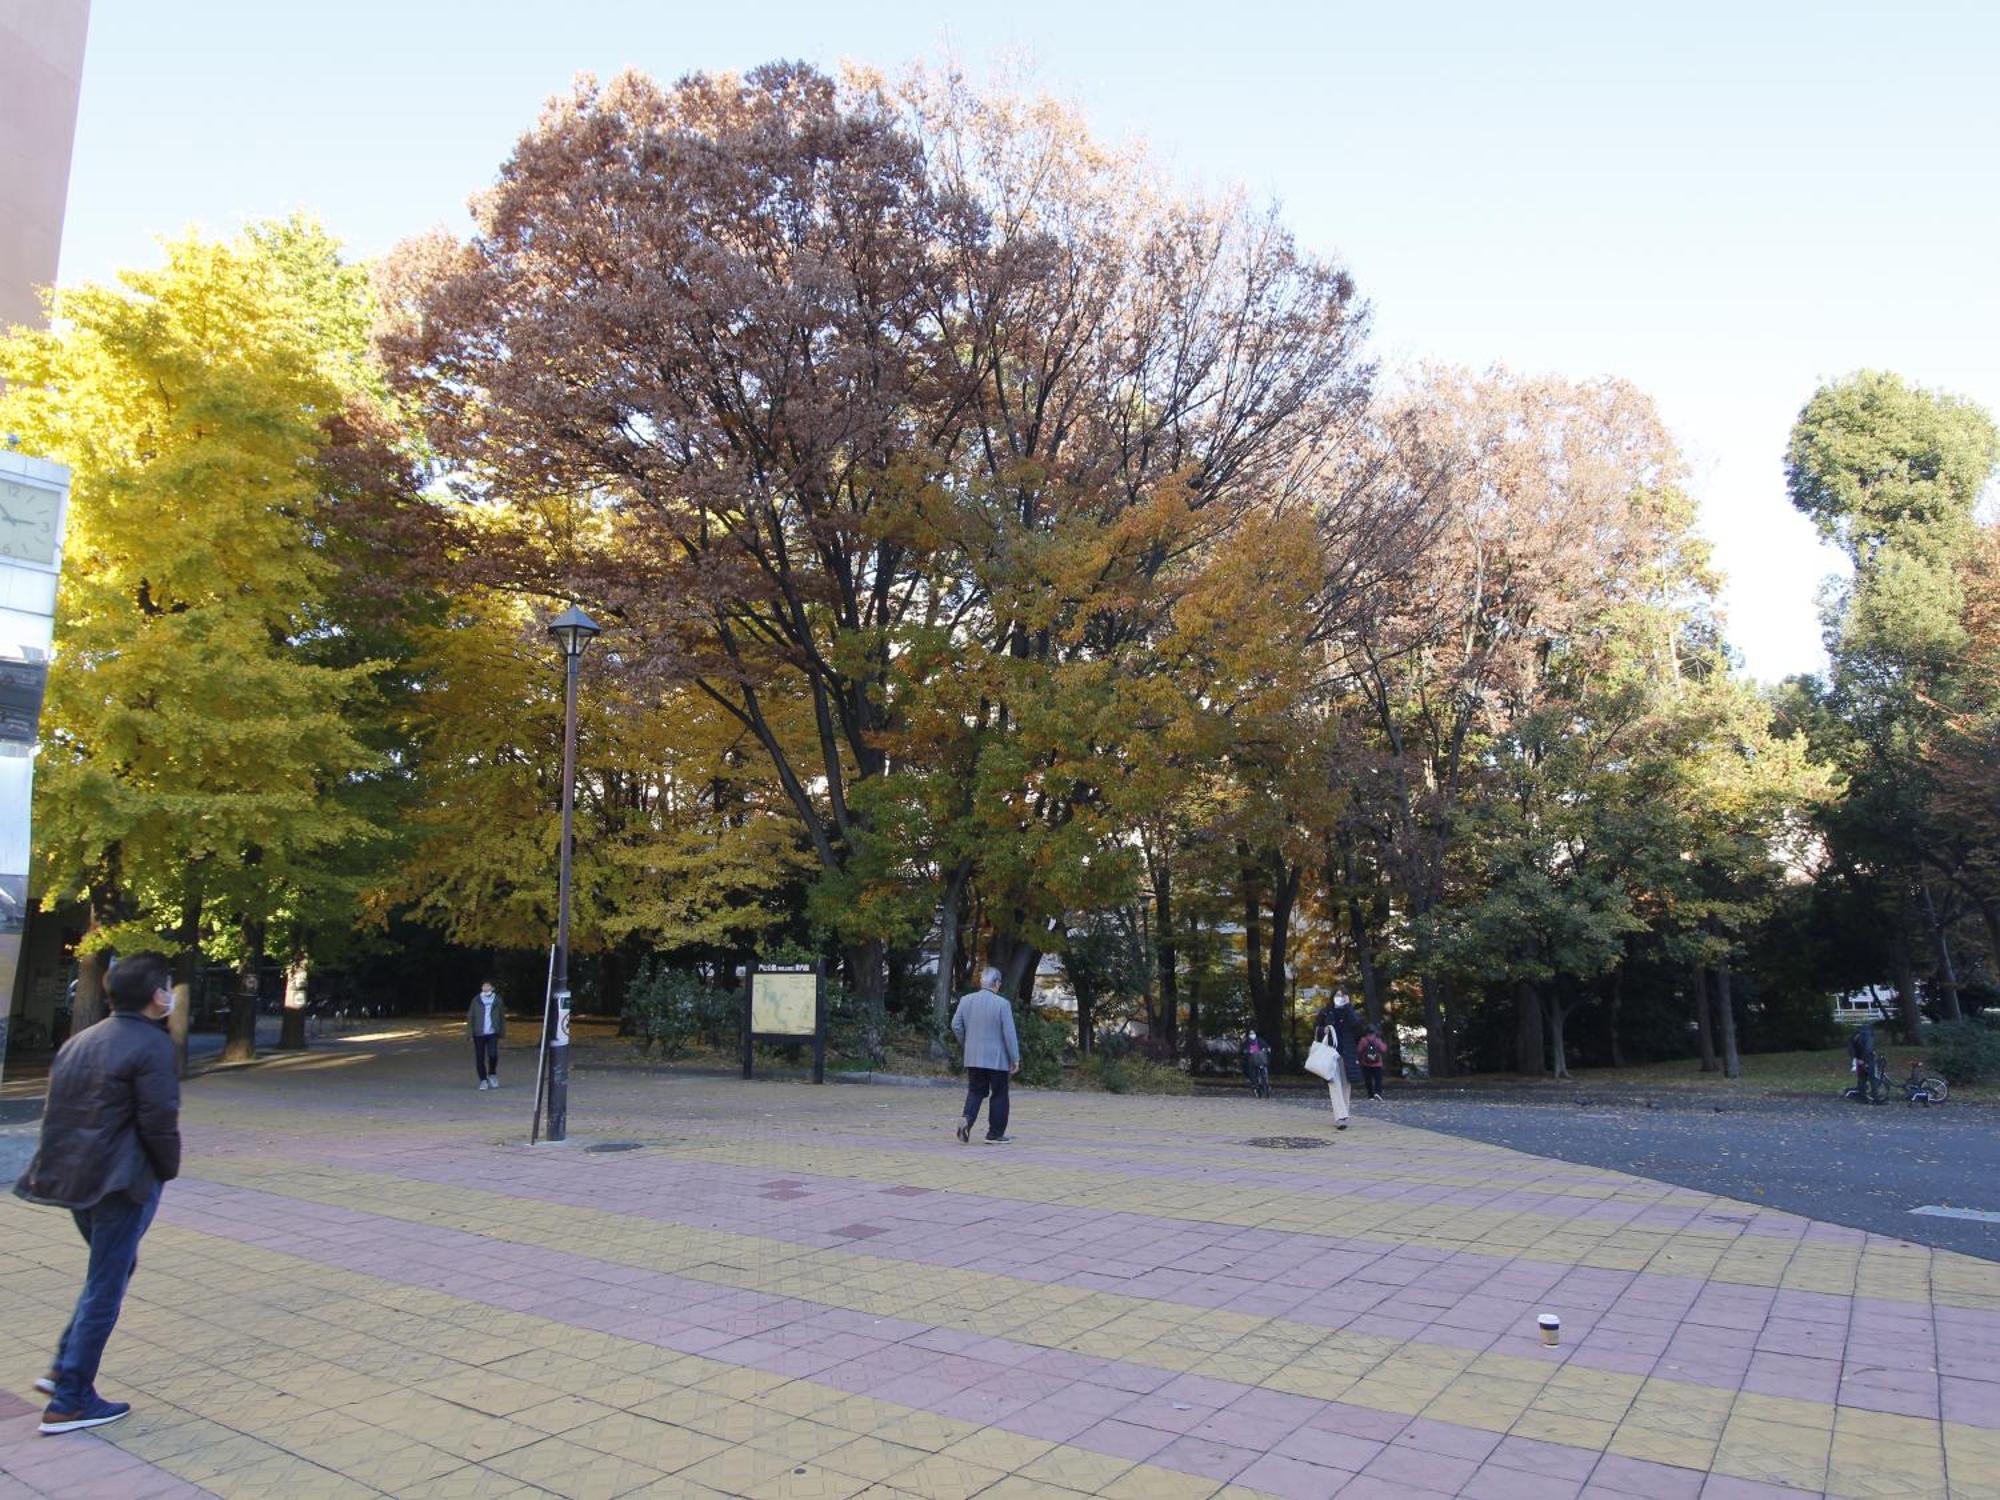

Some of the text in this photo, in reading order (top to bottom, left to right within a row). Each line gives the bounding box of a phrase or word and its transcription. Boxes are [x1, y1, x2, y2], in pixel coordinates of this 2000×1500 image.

[8, 485, 20, 498] 12
[40, 521, 50, 533] 3
[3, 544, 11, 554] 6
